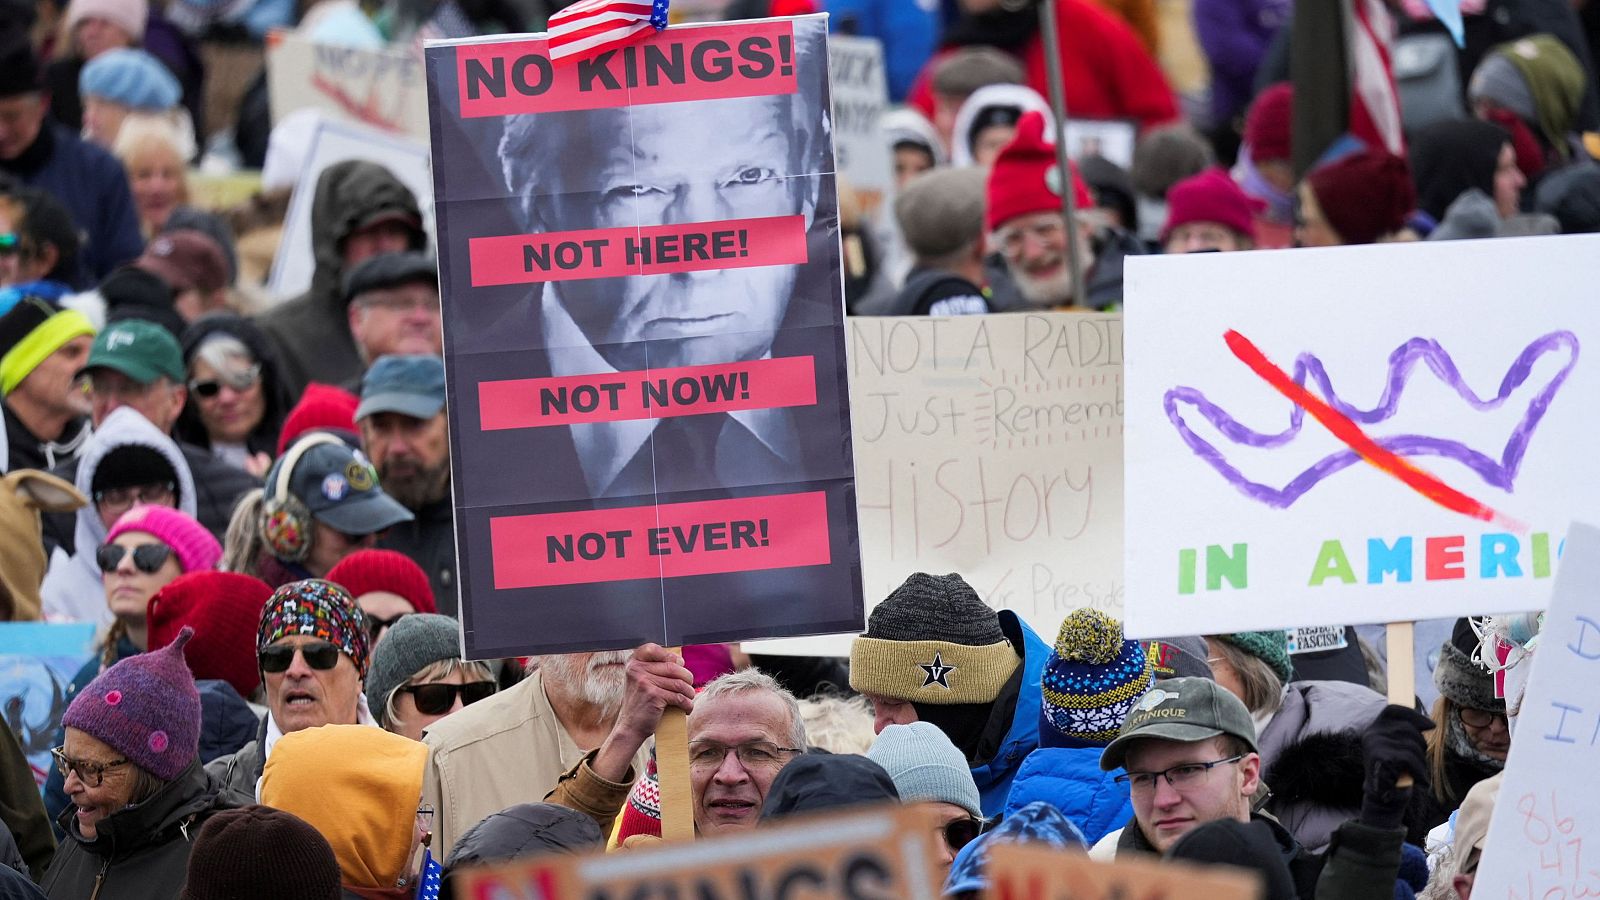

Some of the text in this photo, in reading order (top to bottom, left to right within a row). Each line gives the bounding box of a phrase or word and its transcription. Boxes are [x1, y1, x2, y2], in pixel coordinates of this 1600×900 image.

[464, 34, 793, 101] NO KINGS!
[523, 229, 749, 273] NOT HERE!
[851, 315, 1123, 381] NOT A RADI
[540, 371, 750, 416] NOT NOW!
[546, 518, 770, 563] NOT EVER!
[1178, 532, 1564, 594] IN AMERI
[1297, 632, 1339, 650] FASCISM
[930, 666, 943, 681] V
[1516, 788, 1576, 846] 86
[1539, 837, 1582, 881] 47
